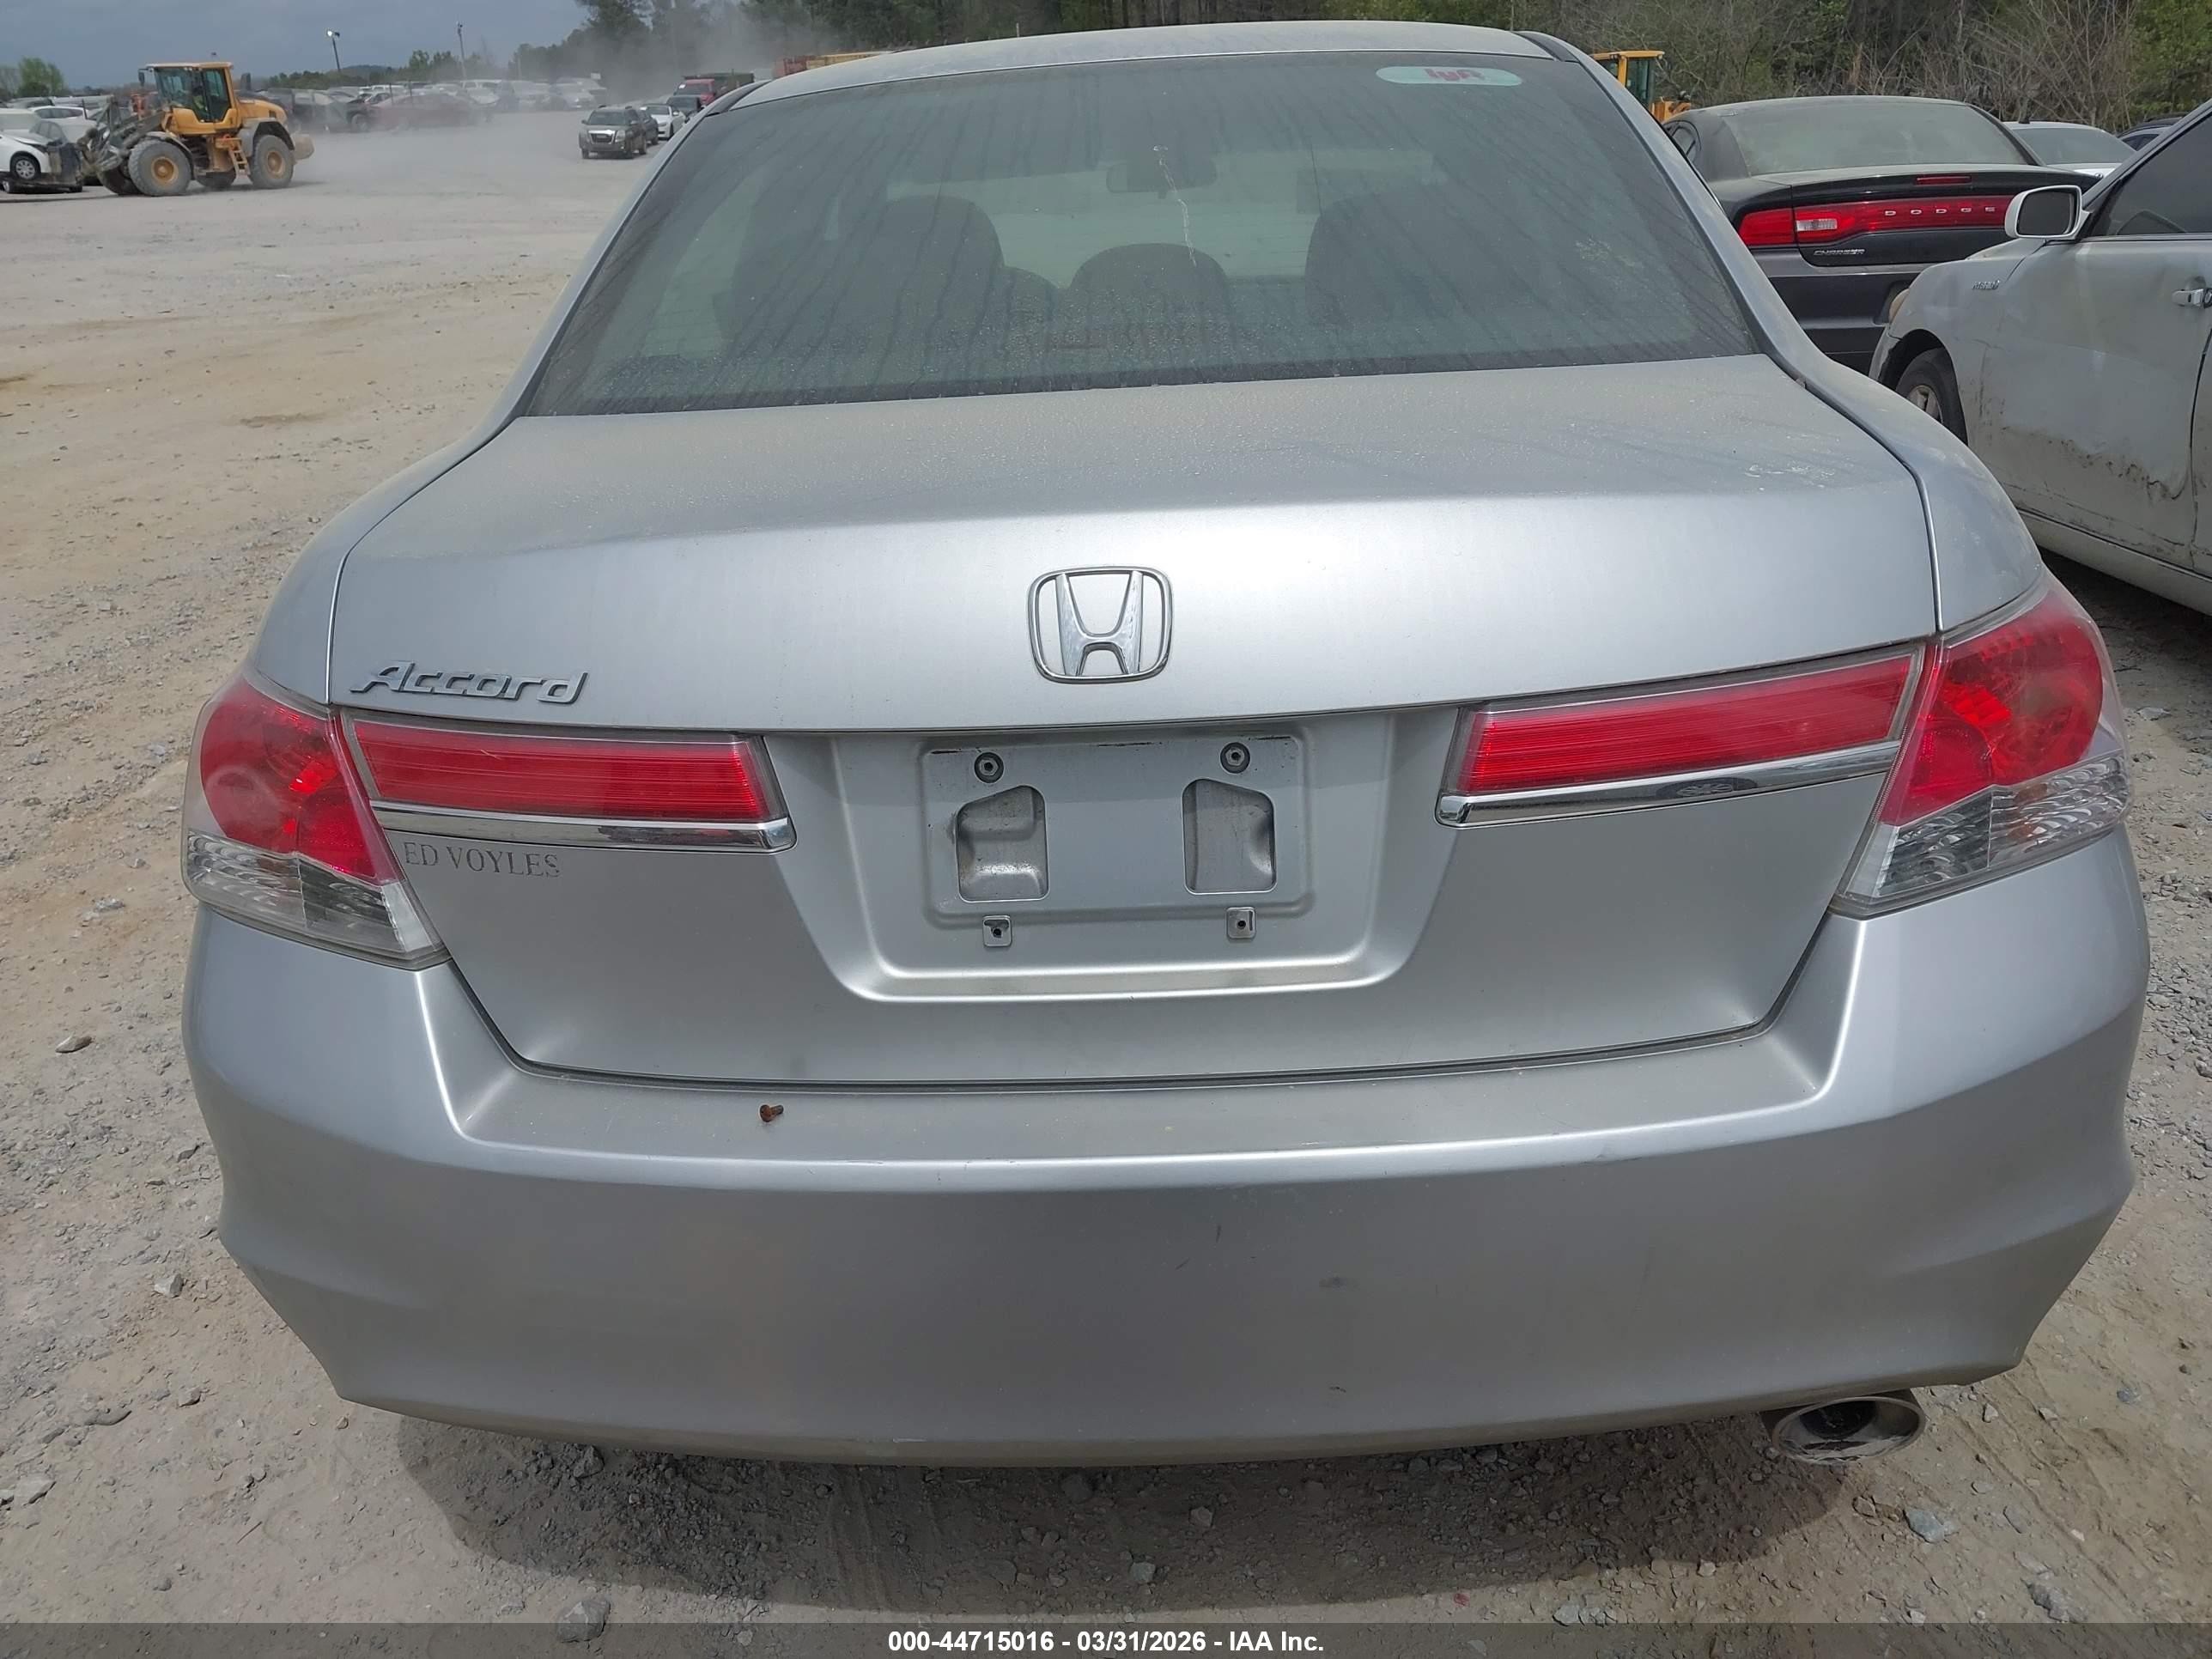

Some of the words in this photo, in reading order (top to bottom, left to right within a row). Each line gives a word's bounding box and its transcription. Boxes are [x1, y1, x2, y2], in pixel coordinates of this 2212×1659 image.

[1884, 207, 1996, 216] DODGE
[349, 659, 588, 705] Accord
[403, 842, 439, 866] ED
[446, 846, 561, 878] VOYLES
